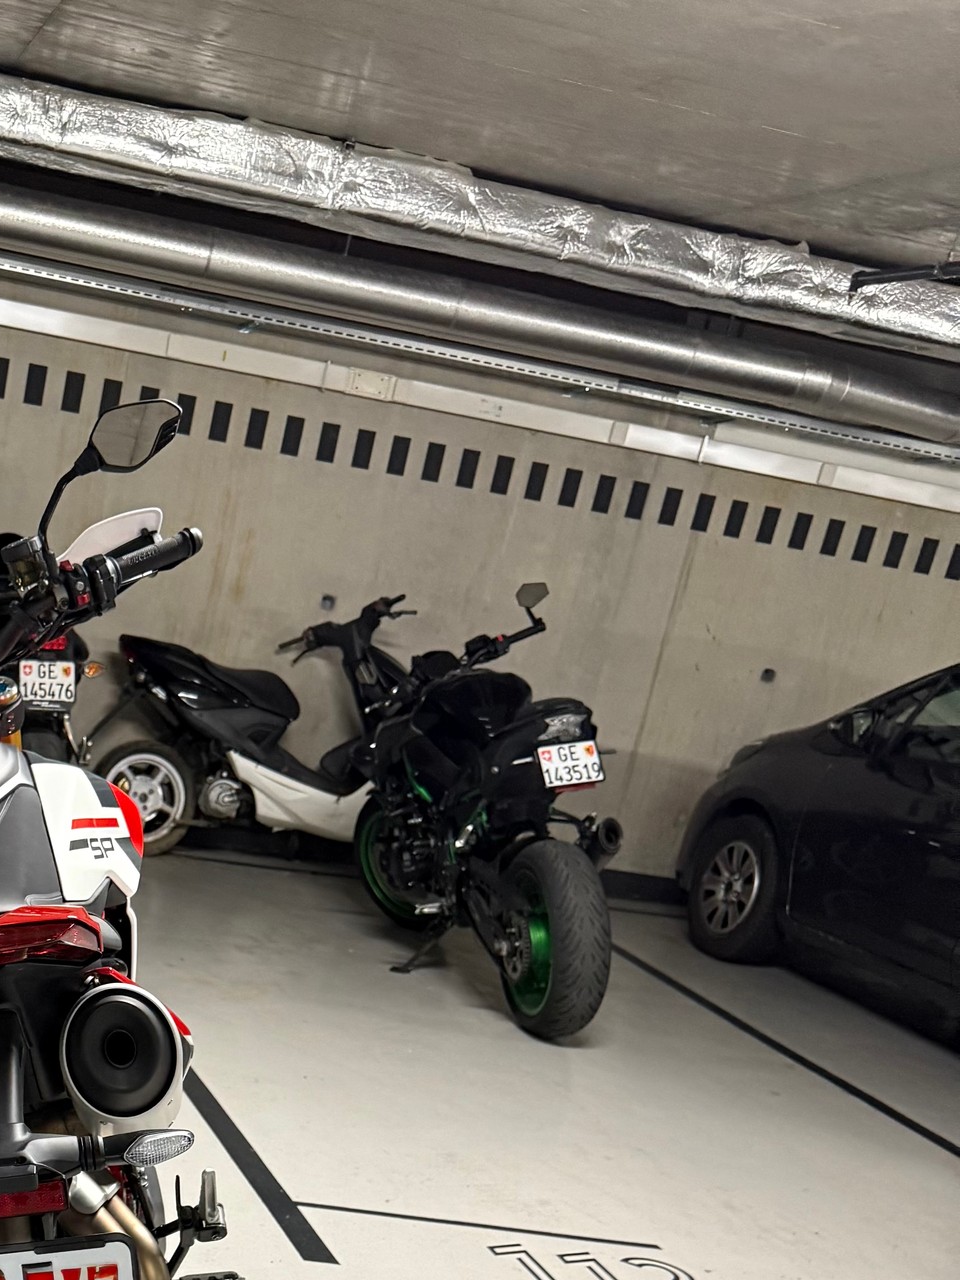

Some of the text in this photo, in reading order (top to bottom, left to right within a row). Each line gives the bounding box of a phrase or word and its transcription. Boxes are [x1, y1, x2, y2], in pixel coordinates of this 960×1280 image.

[38, 663, 58, 680] GE
[22, 682, 74, 700] 145476
[557, 745, 580, 762] GE
[544, 762, 601, 784] 143519
[89, 837, 114, 859] SP
